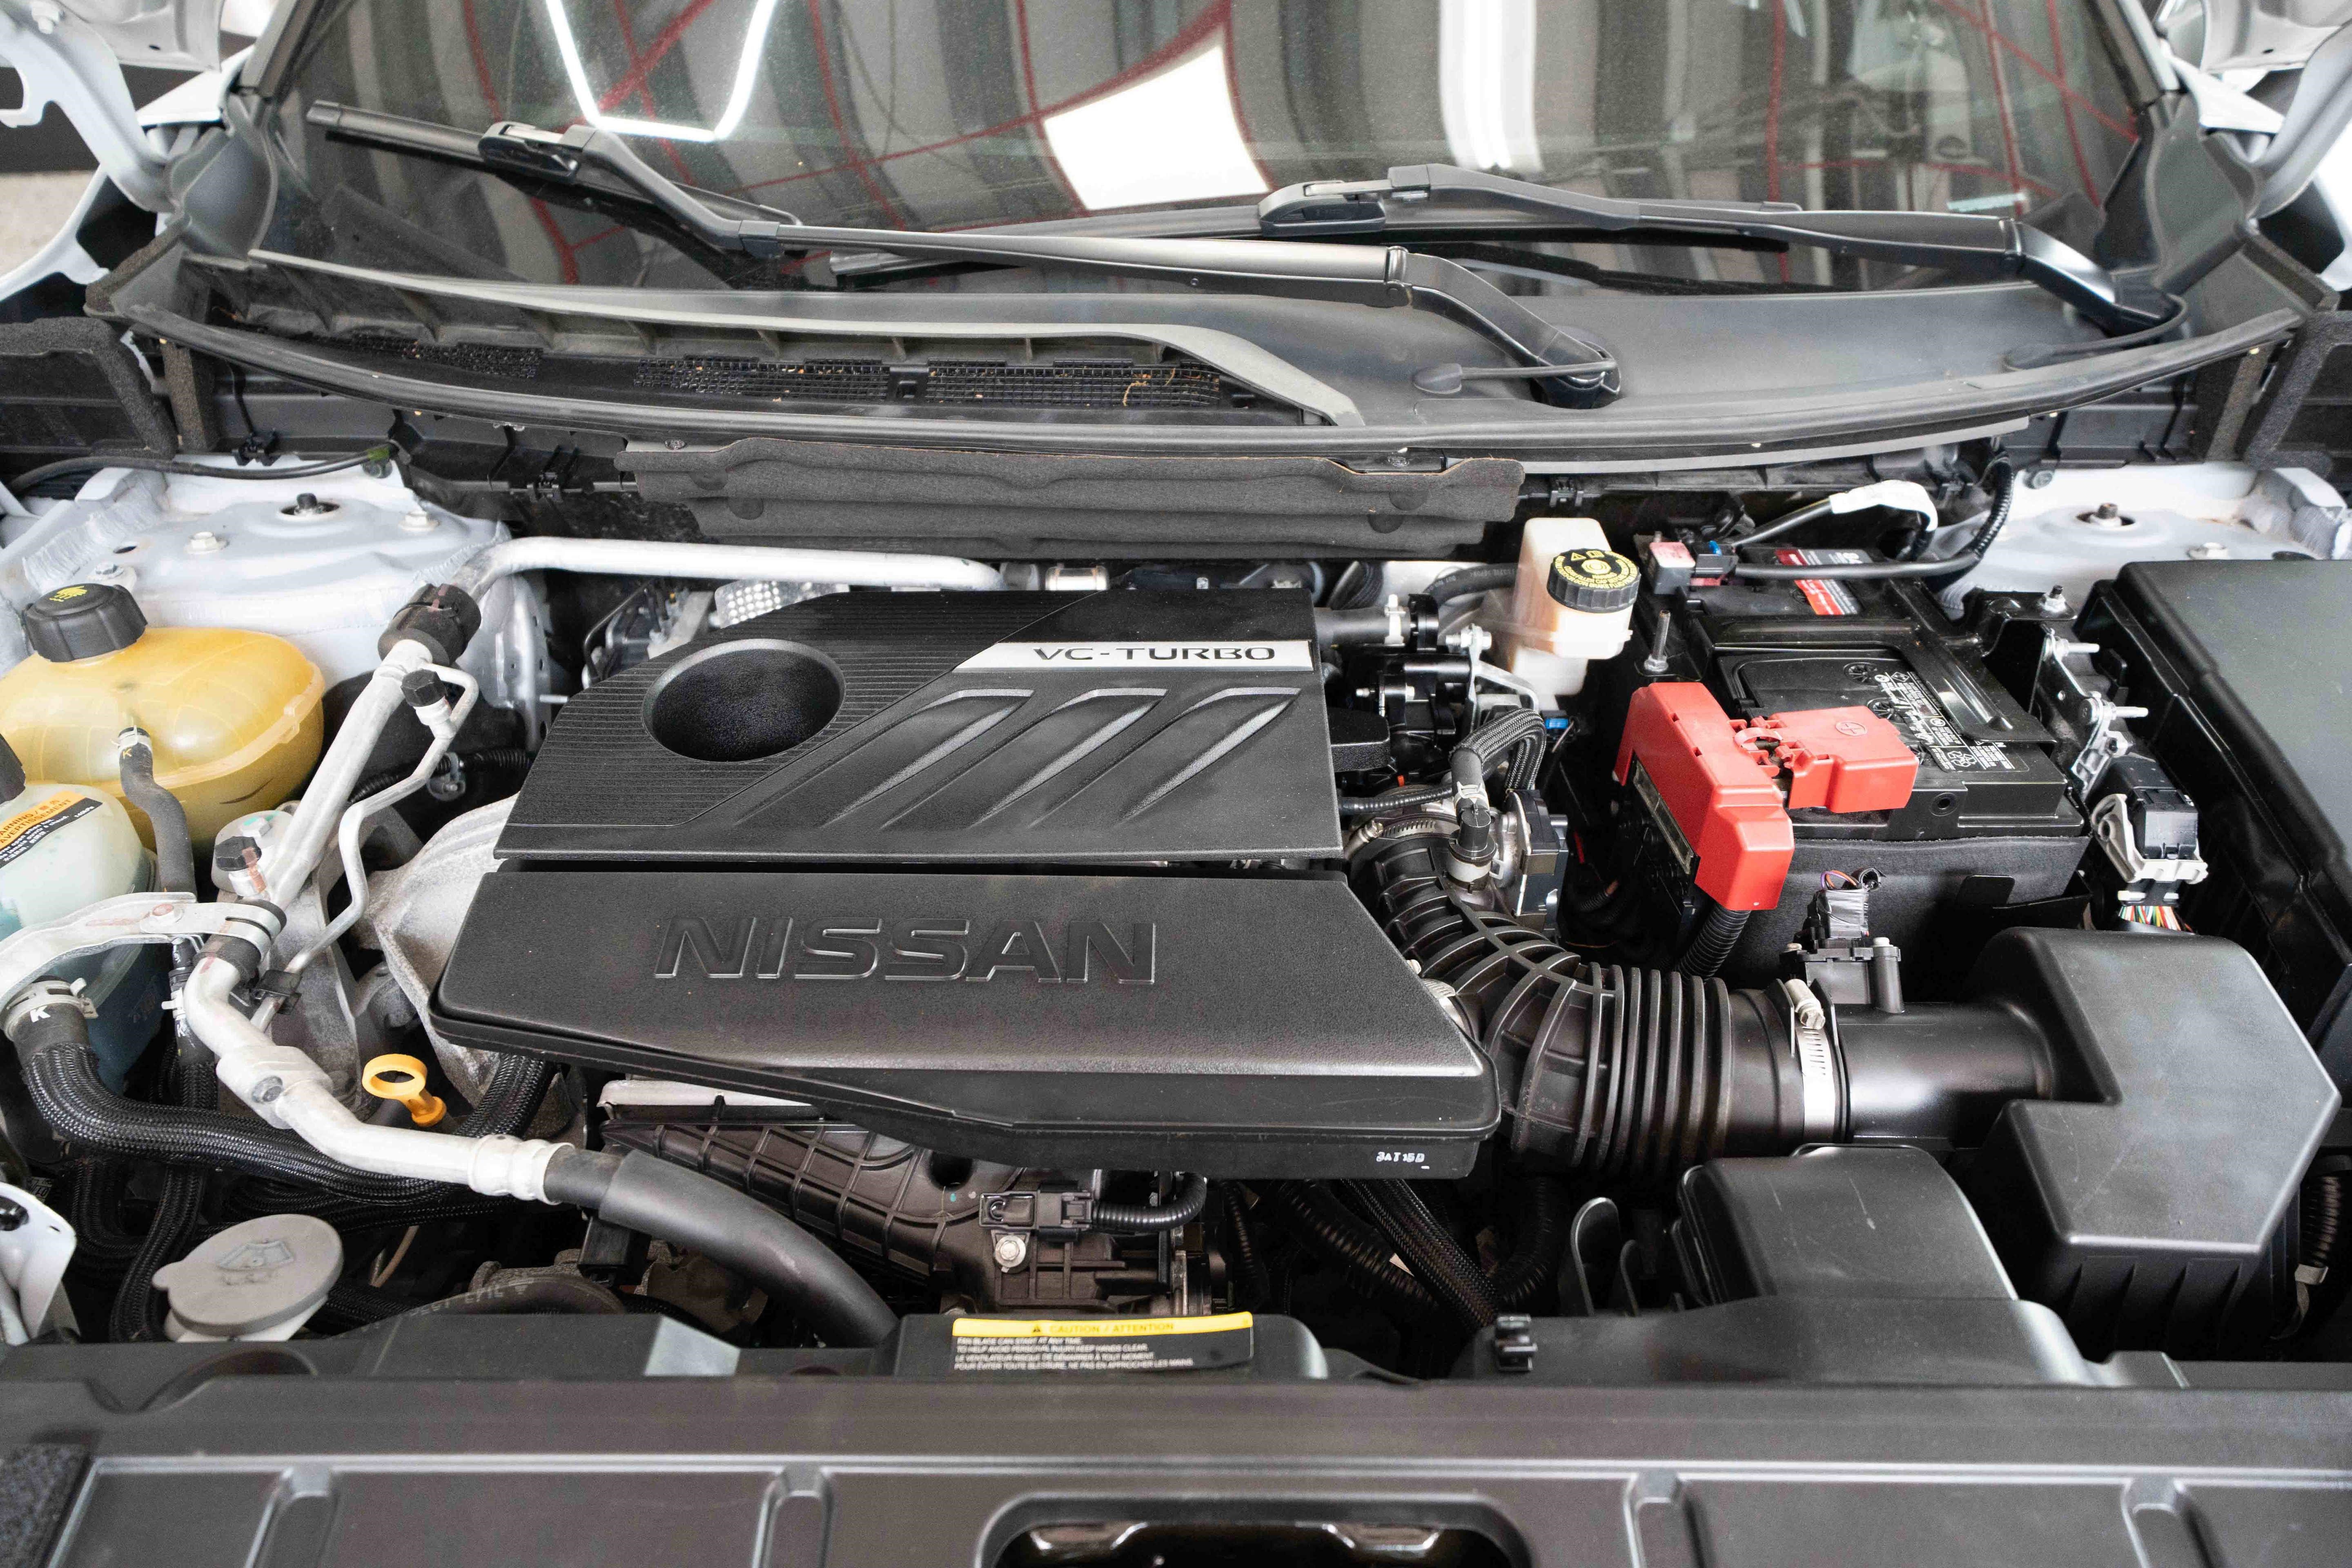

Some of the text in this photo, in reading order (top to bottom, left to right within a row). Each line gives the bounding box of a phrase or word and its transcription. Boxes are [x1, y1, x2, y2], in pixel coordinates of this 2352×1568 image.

[1033, 648, 1275, 660] VC-TURBO
[0, 799, 71, 843] AVERTISSEMENT
[0, 813, 33, 835] ARNING
[11, 835, 26, 846] open
[25, 824, 41, 835] when
[655, 917, 1155, 983] NISSAN
[30, 1005, 51, 1022] K
[1112, 1323, 1174, 1332] ATTENTION
